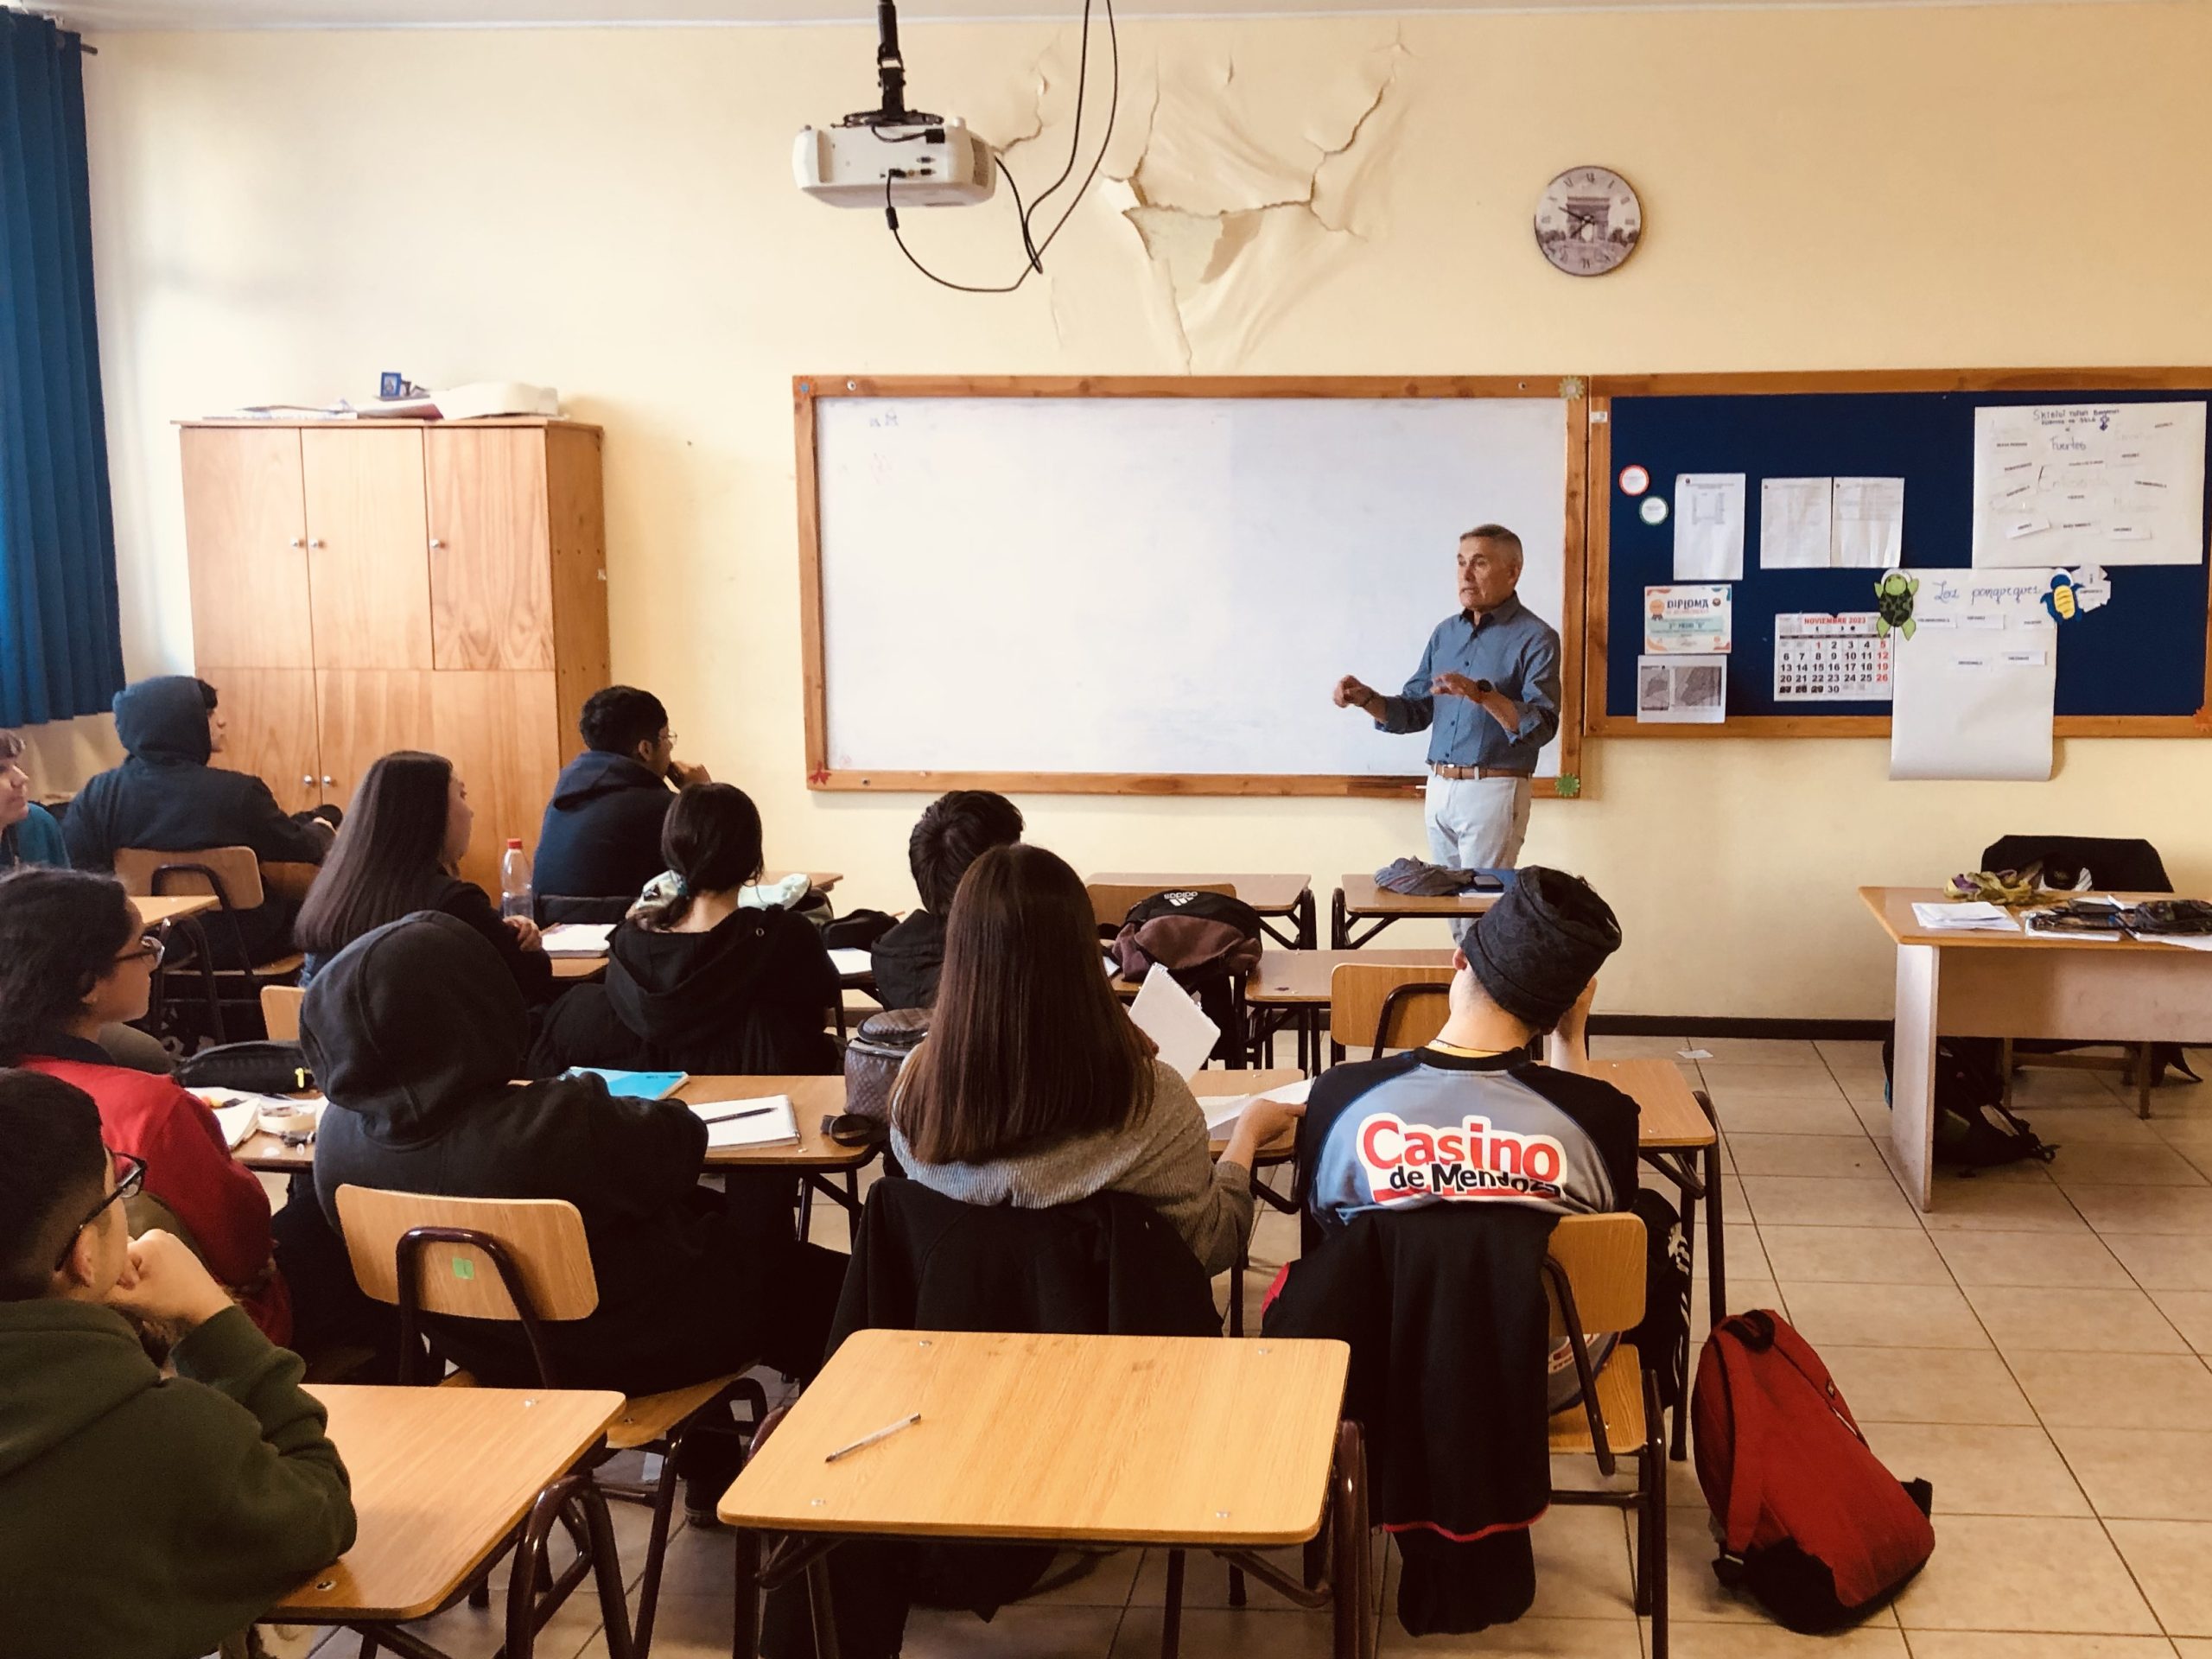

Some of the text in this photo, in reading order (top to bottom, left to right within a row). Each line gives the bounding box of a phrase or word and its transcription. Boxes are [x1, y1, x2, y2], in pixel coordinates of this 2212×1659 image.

[1932, 580, 1960, 603] Los
[1667, 599, 1709, 610] DIPLOMA
[1828, 663, 1840, 671] 16
[1876, 674, 1888, 683] 26
[1163, 891, 1198, 899] adidas
[1363, 1120, 1560, 1183] Casino
[1389, 1165, 1424, 1190] de
